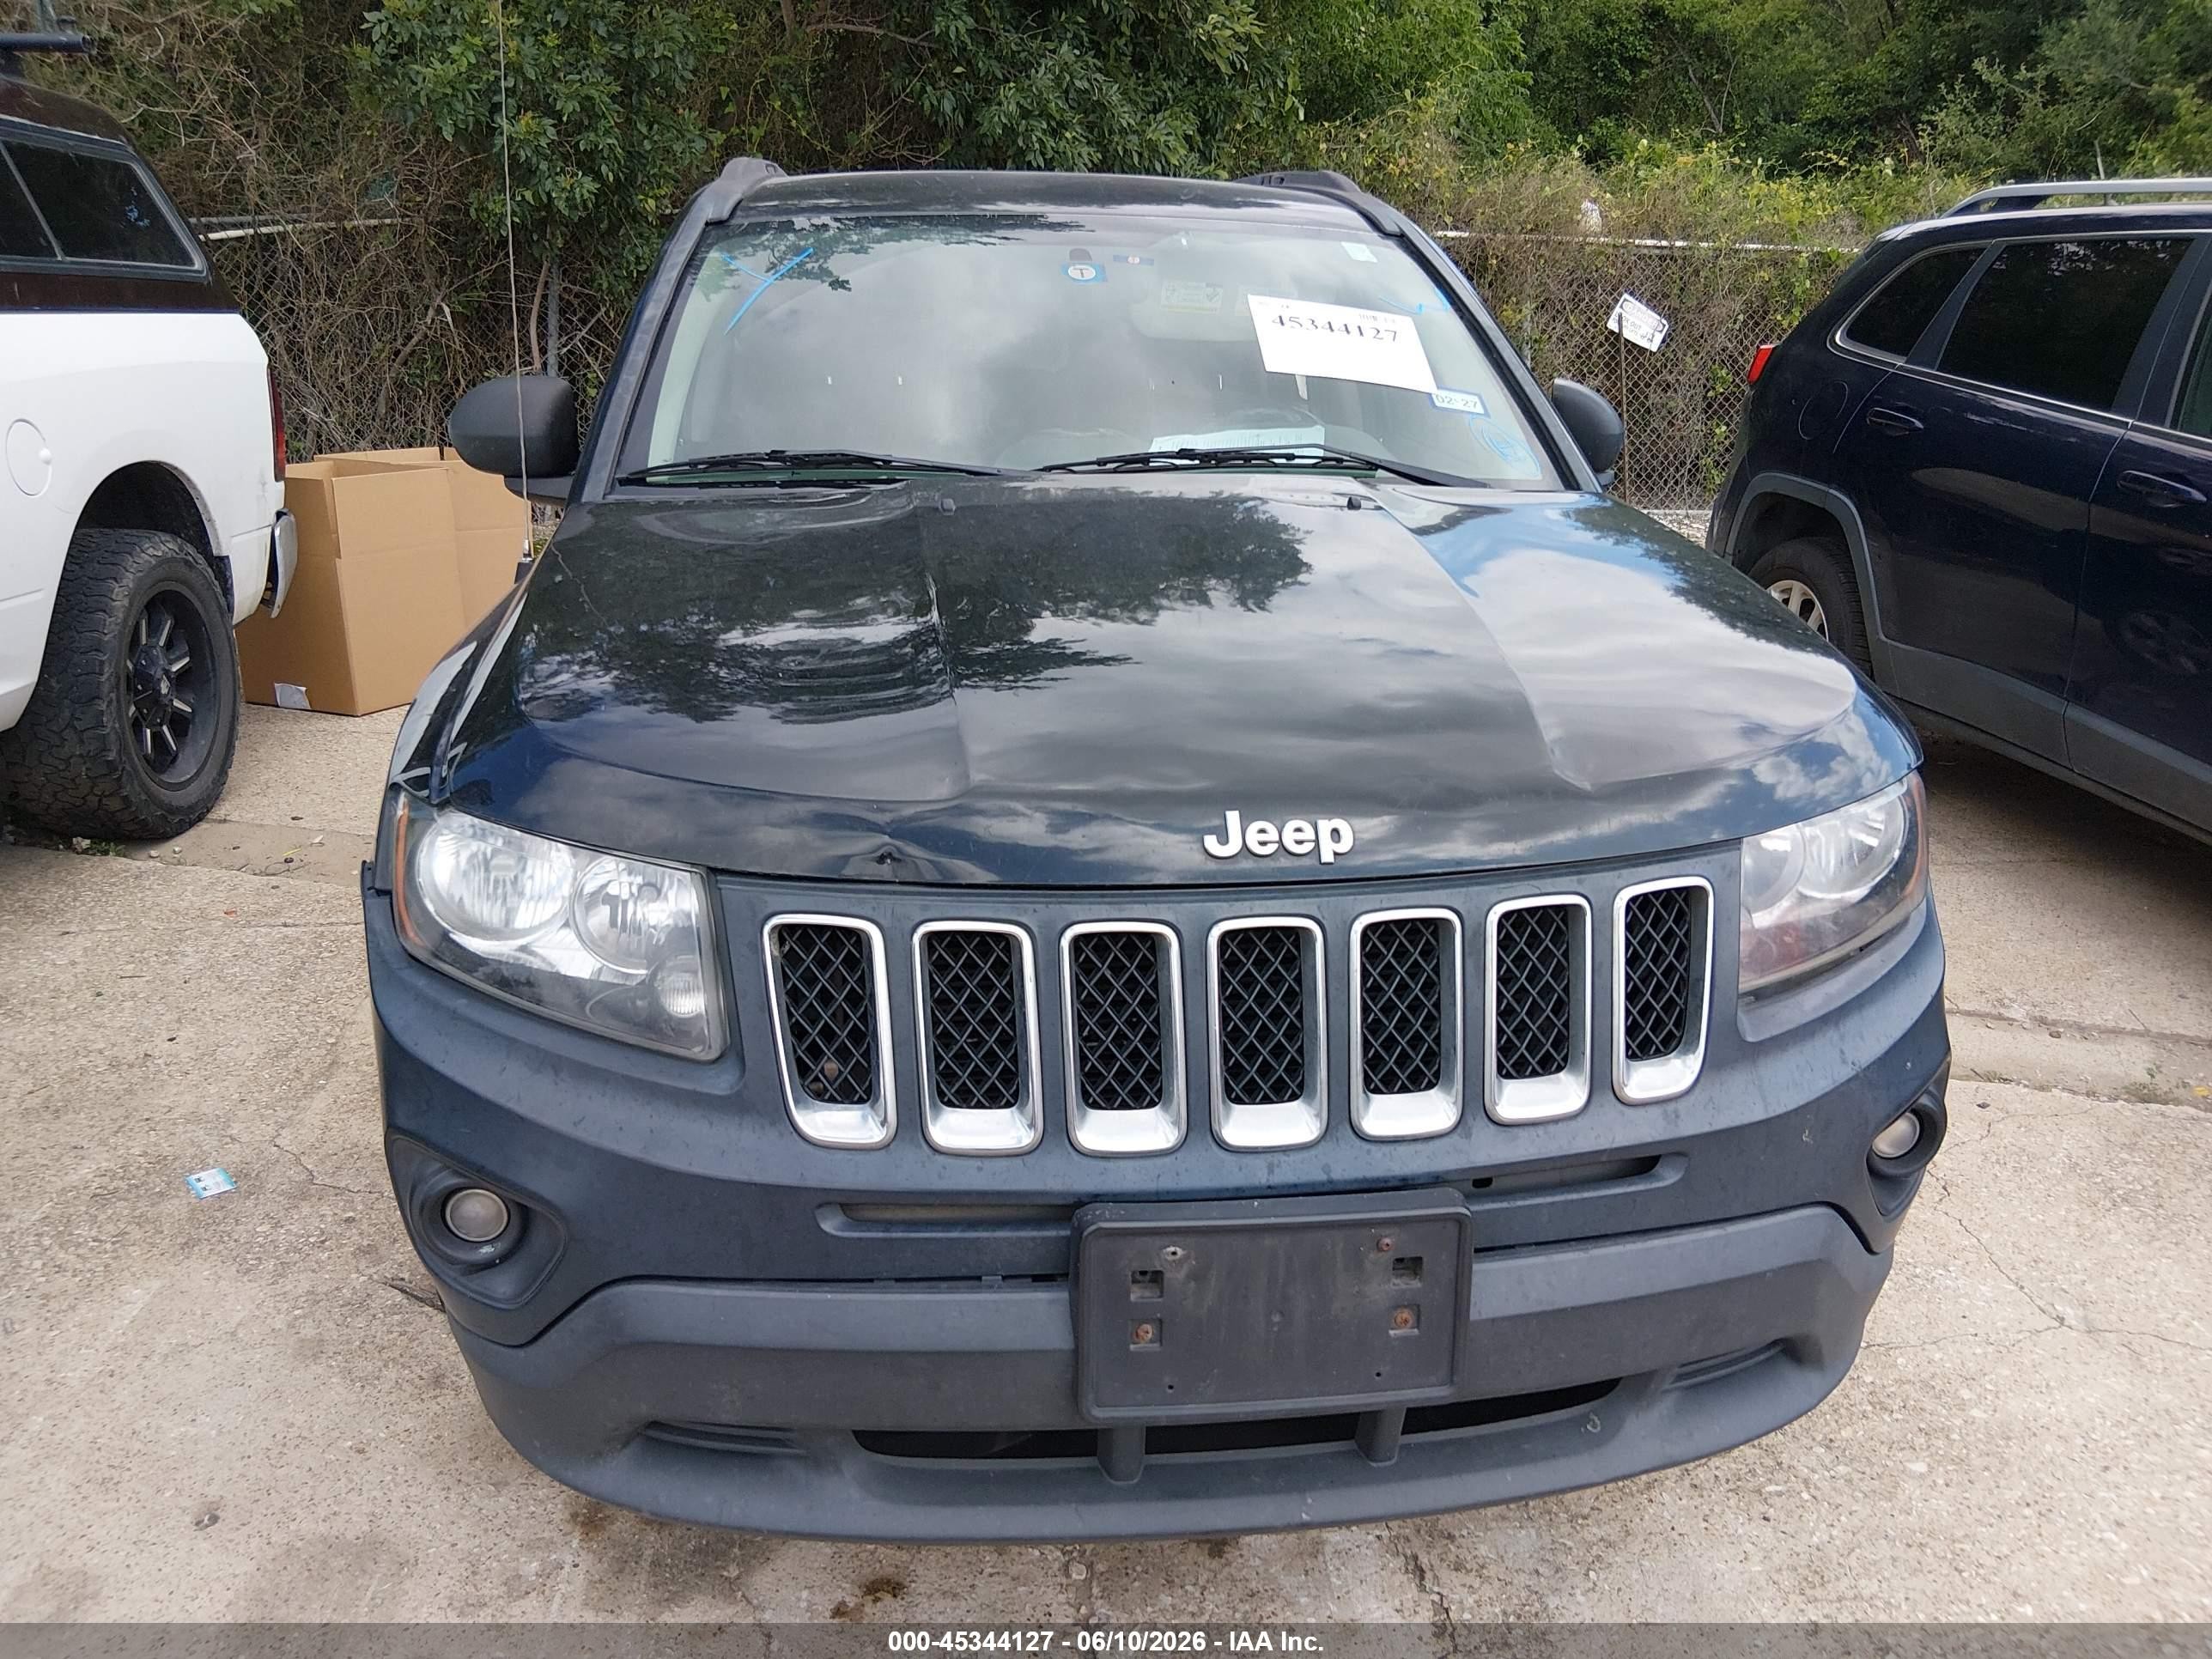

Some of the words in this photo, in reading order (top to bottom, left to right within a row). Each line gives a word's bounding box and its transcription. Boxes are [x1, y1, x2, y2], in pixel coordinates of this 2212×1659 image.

[1271, 314, 1398, 343] 45344127
[1435, 394, 1478, 410] 02-27
[1203, 810, 1354, 864] Jeep
